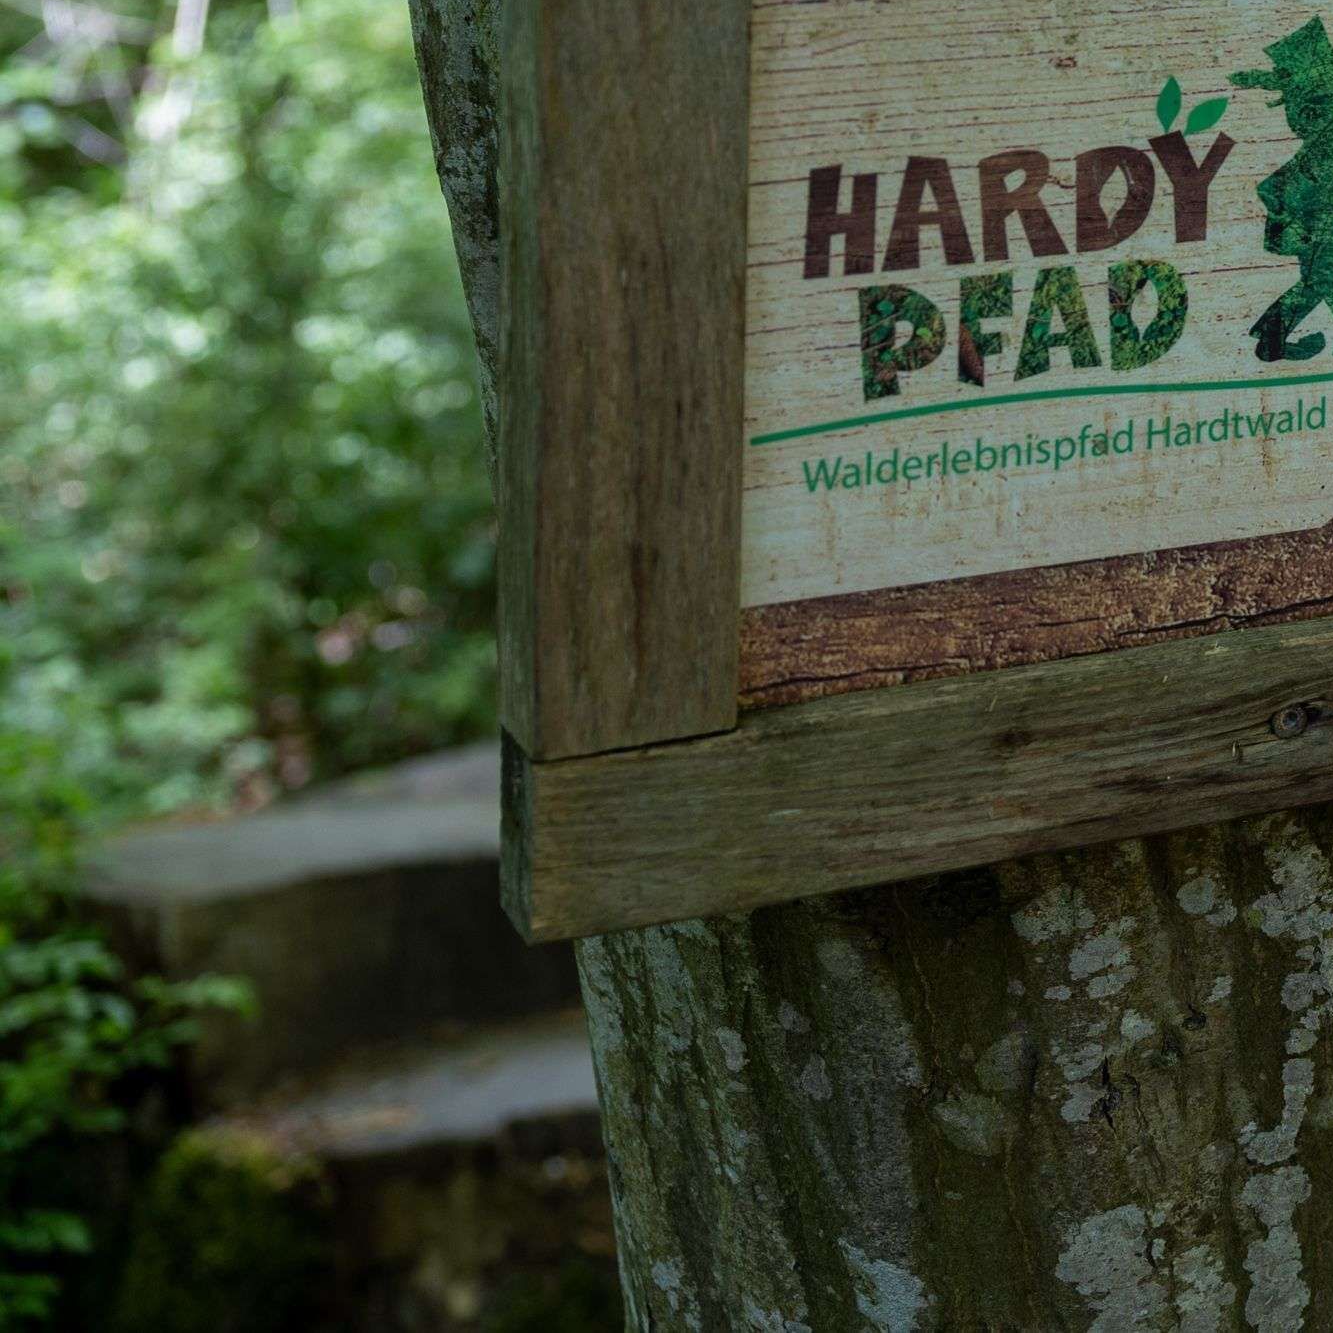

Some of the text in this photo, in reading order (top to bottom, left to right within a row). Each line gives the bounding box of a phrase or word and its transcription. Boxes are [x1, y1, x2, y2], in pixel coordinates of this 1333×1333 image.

[802, 130, 1237, 280] HARDY
[857, 259, 1190, 404] PFAD
[802, 396, 1328, 494] Walderlebnispfad Hardtwald
